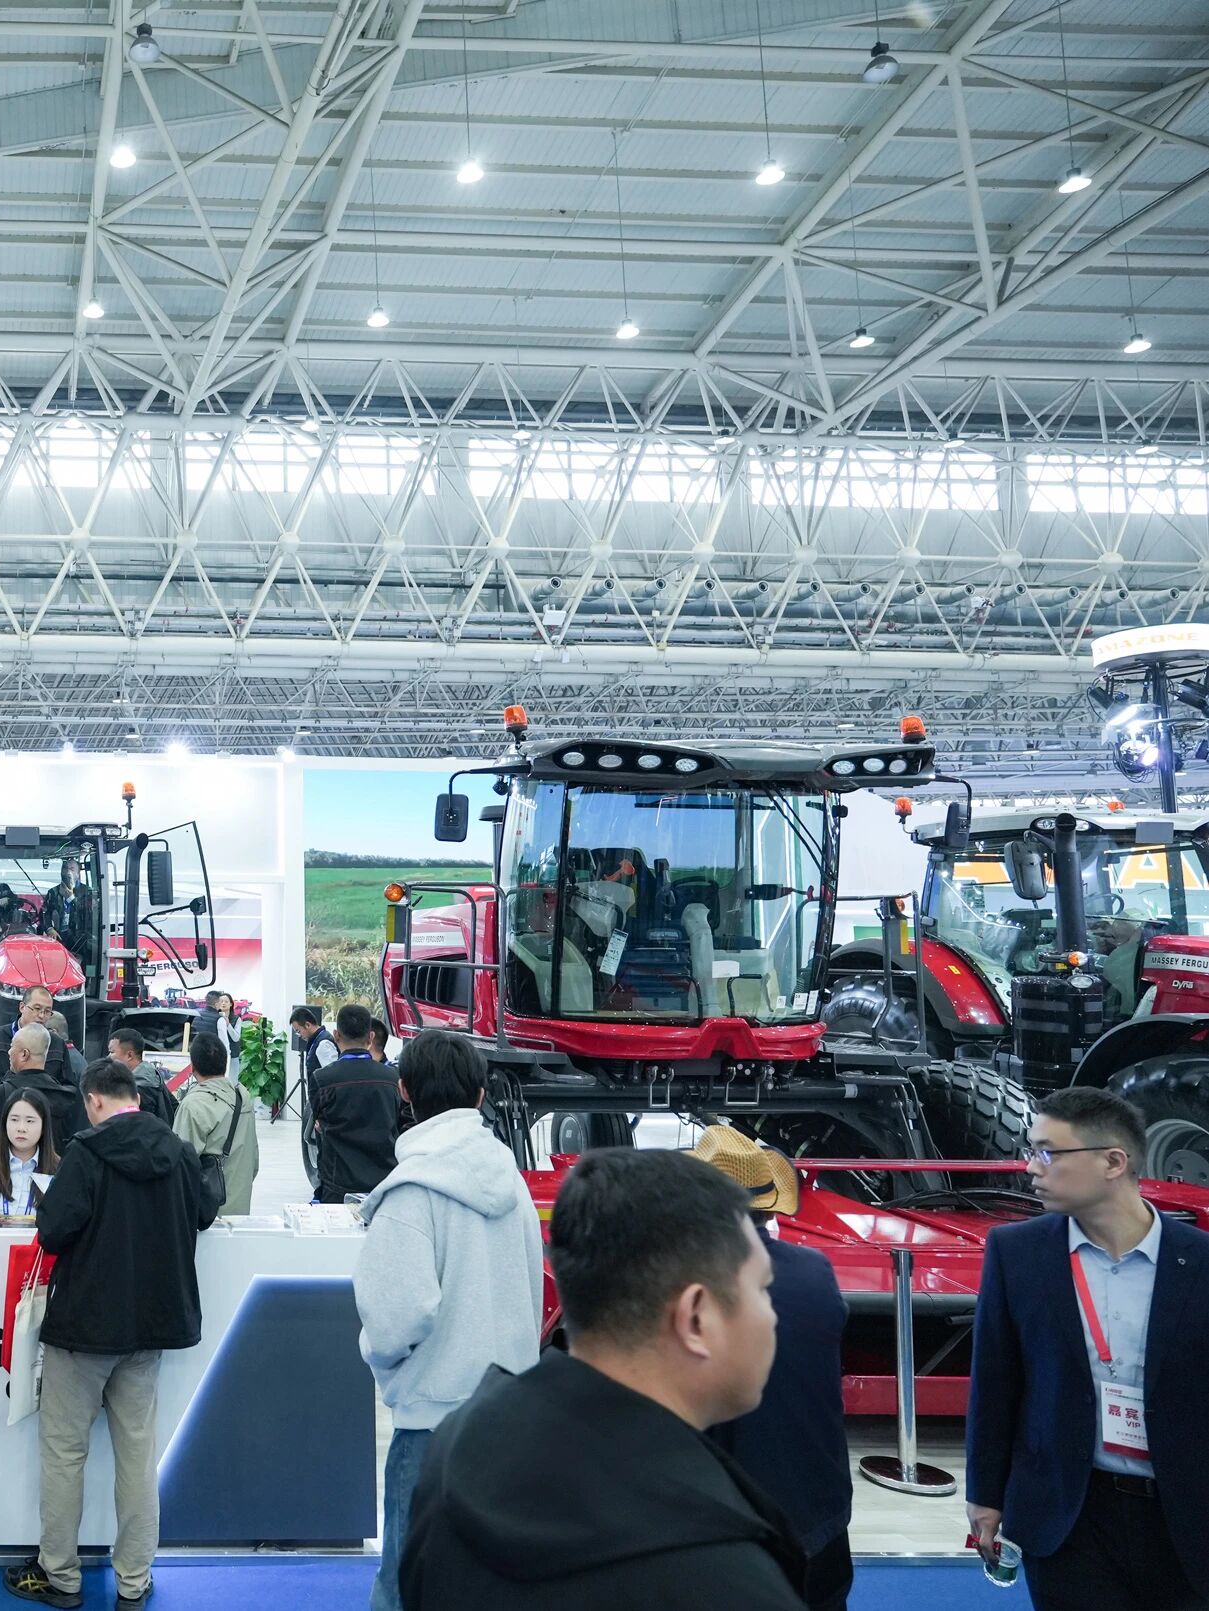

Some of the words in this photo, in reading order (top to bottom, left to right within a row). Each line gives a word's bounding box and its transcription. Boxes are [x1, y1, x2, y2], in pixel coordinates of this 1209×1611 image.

[152, 960, 199, 971] FERGUSO
[1151, 956, 1179, 965] MASSEY
[1108, 1404, 1140, 1421] 嘉宾
[1126, 1420, 1141, 1429] VIP
